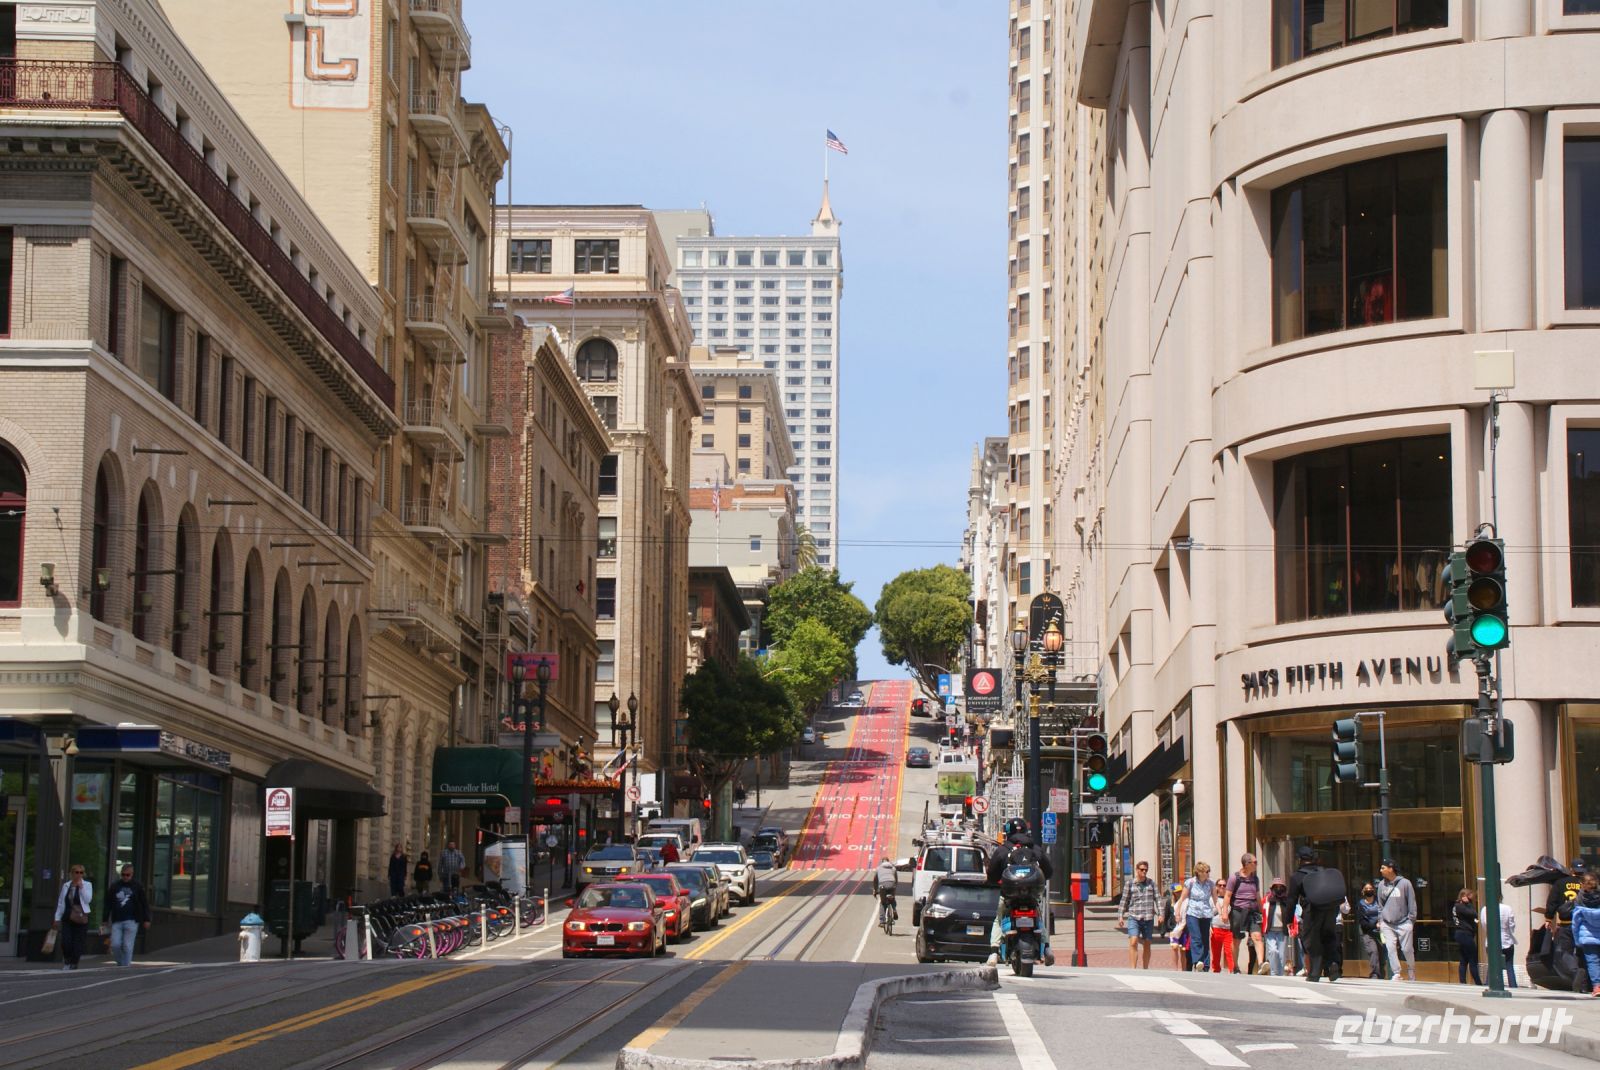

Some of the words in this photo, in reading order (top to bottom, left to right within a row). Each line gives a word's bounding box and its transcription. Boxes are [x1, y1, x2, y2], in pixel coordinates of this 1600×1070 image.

[1241, 668, 1278, 692] SAKS
[1285, 661, 1343, 687] FIFTH
[440, 783, 479, 792] Chancellor
[481, 782, 499, 792] Hotel
